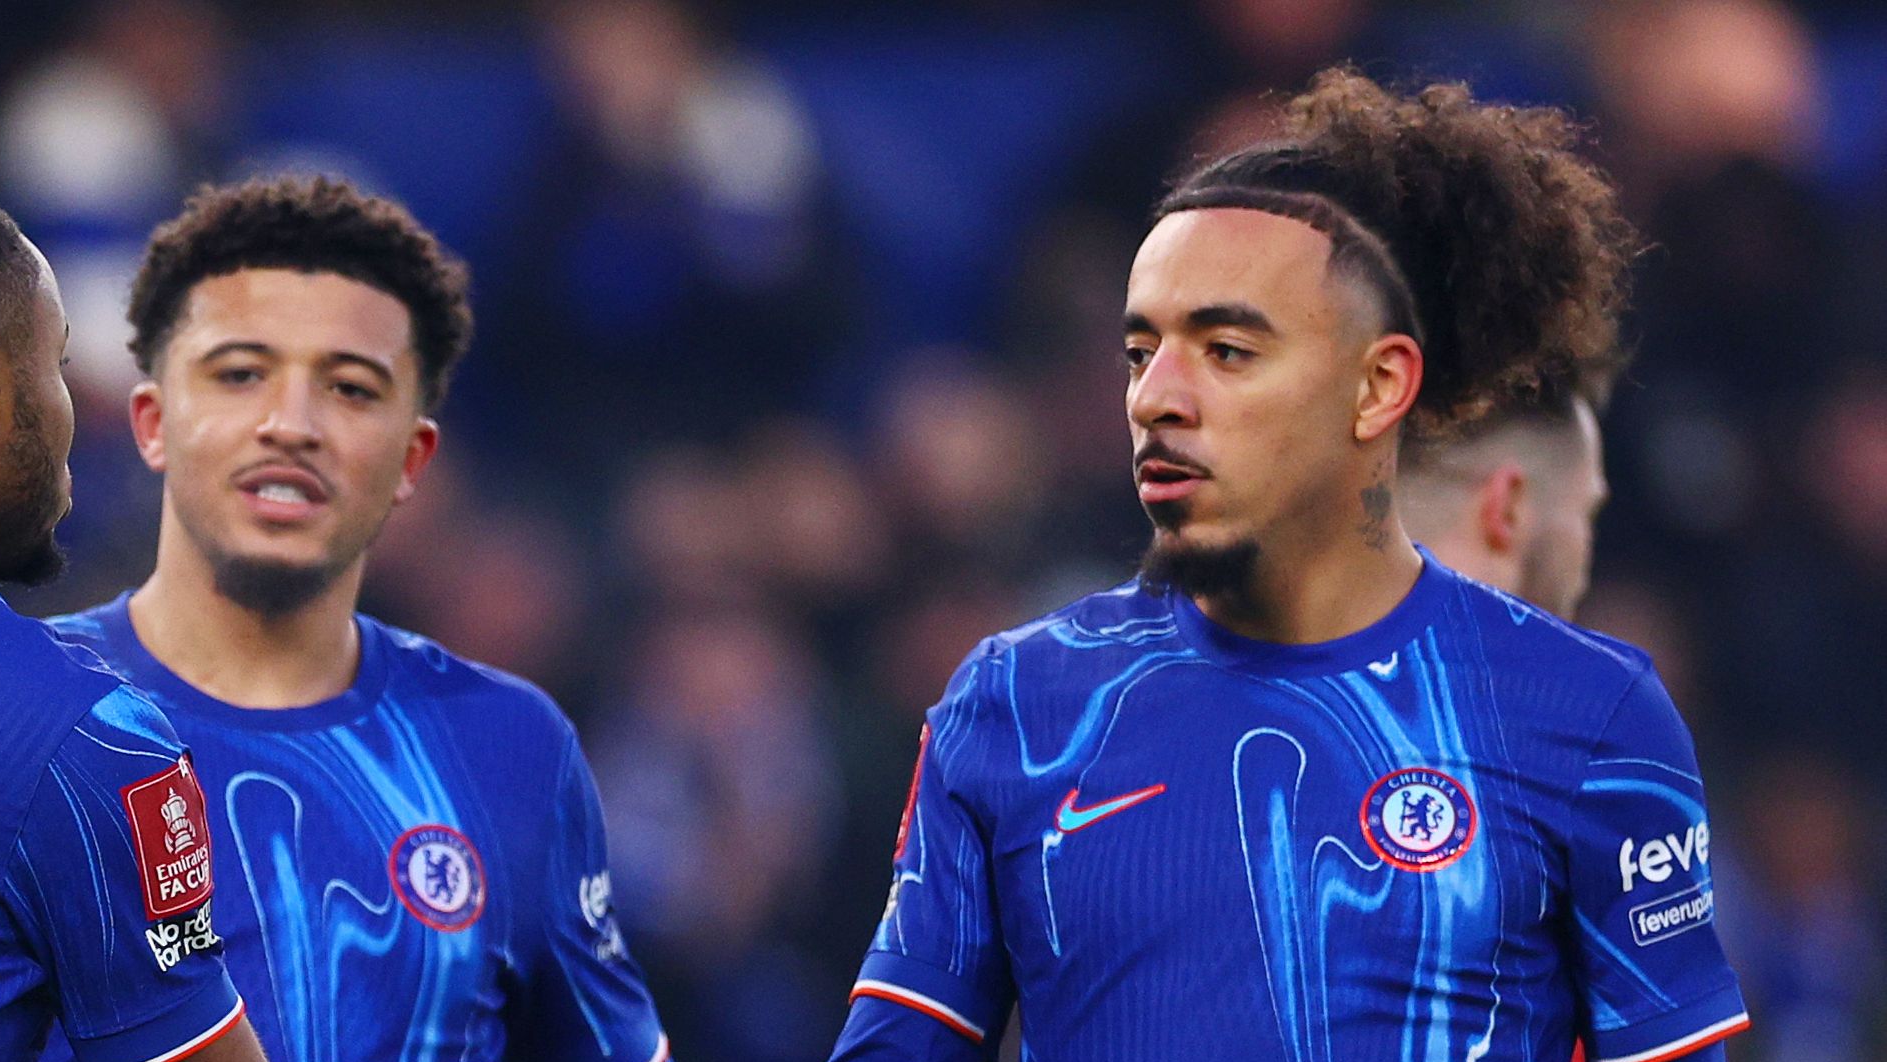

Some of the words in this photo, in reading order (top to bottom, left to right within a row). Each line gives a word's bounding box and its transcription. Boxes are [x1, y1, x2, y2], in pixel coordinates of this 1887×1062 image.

[1387, 772, 1457, 798] CHELSEA
[156, 842, 209, 881] Emirates
[159, 877, 186, 901] FA
[186, 859, 209, 889] CUP
[145, 922, 179, 953] No
[153, 941, 182, 972] for
